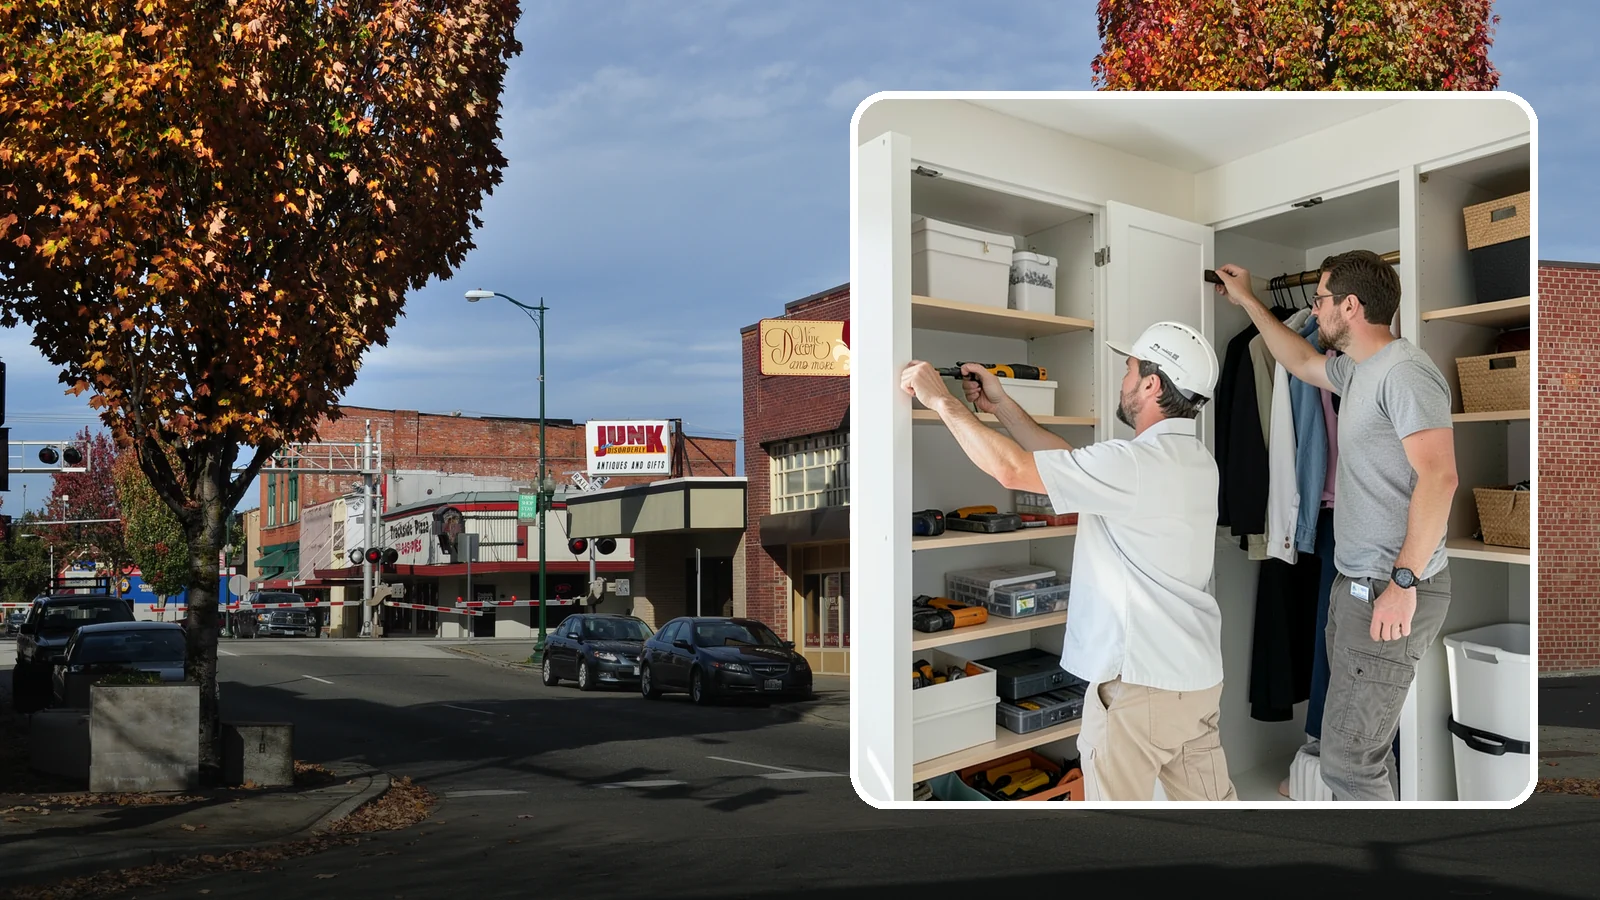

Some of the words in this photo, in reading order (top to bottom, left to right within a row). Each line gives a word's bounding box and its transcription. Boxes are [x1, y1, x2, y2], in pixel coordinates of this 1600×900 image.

[595, 425, 665, 457] JUNK
[607, 446, 646, 454] DISORDERLY
[597, 461, 628, 470] ANTIQUES
[631, 461, 644, 470] AND
[647, 460, 665, 469] GIFTS
[390, 521, 413, 539] Trackside
